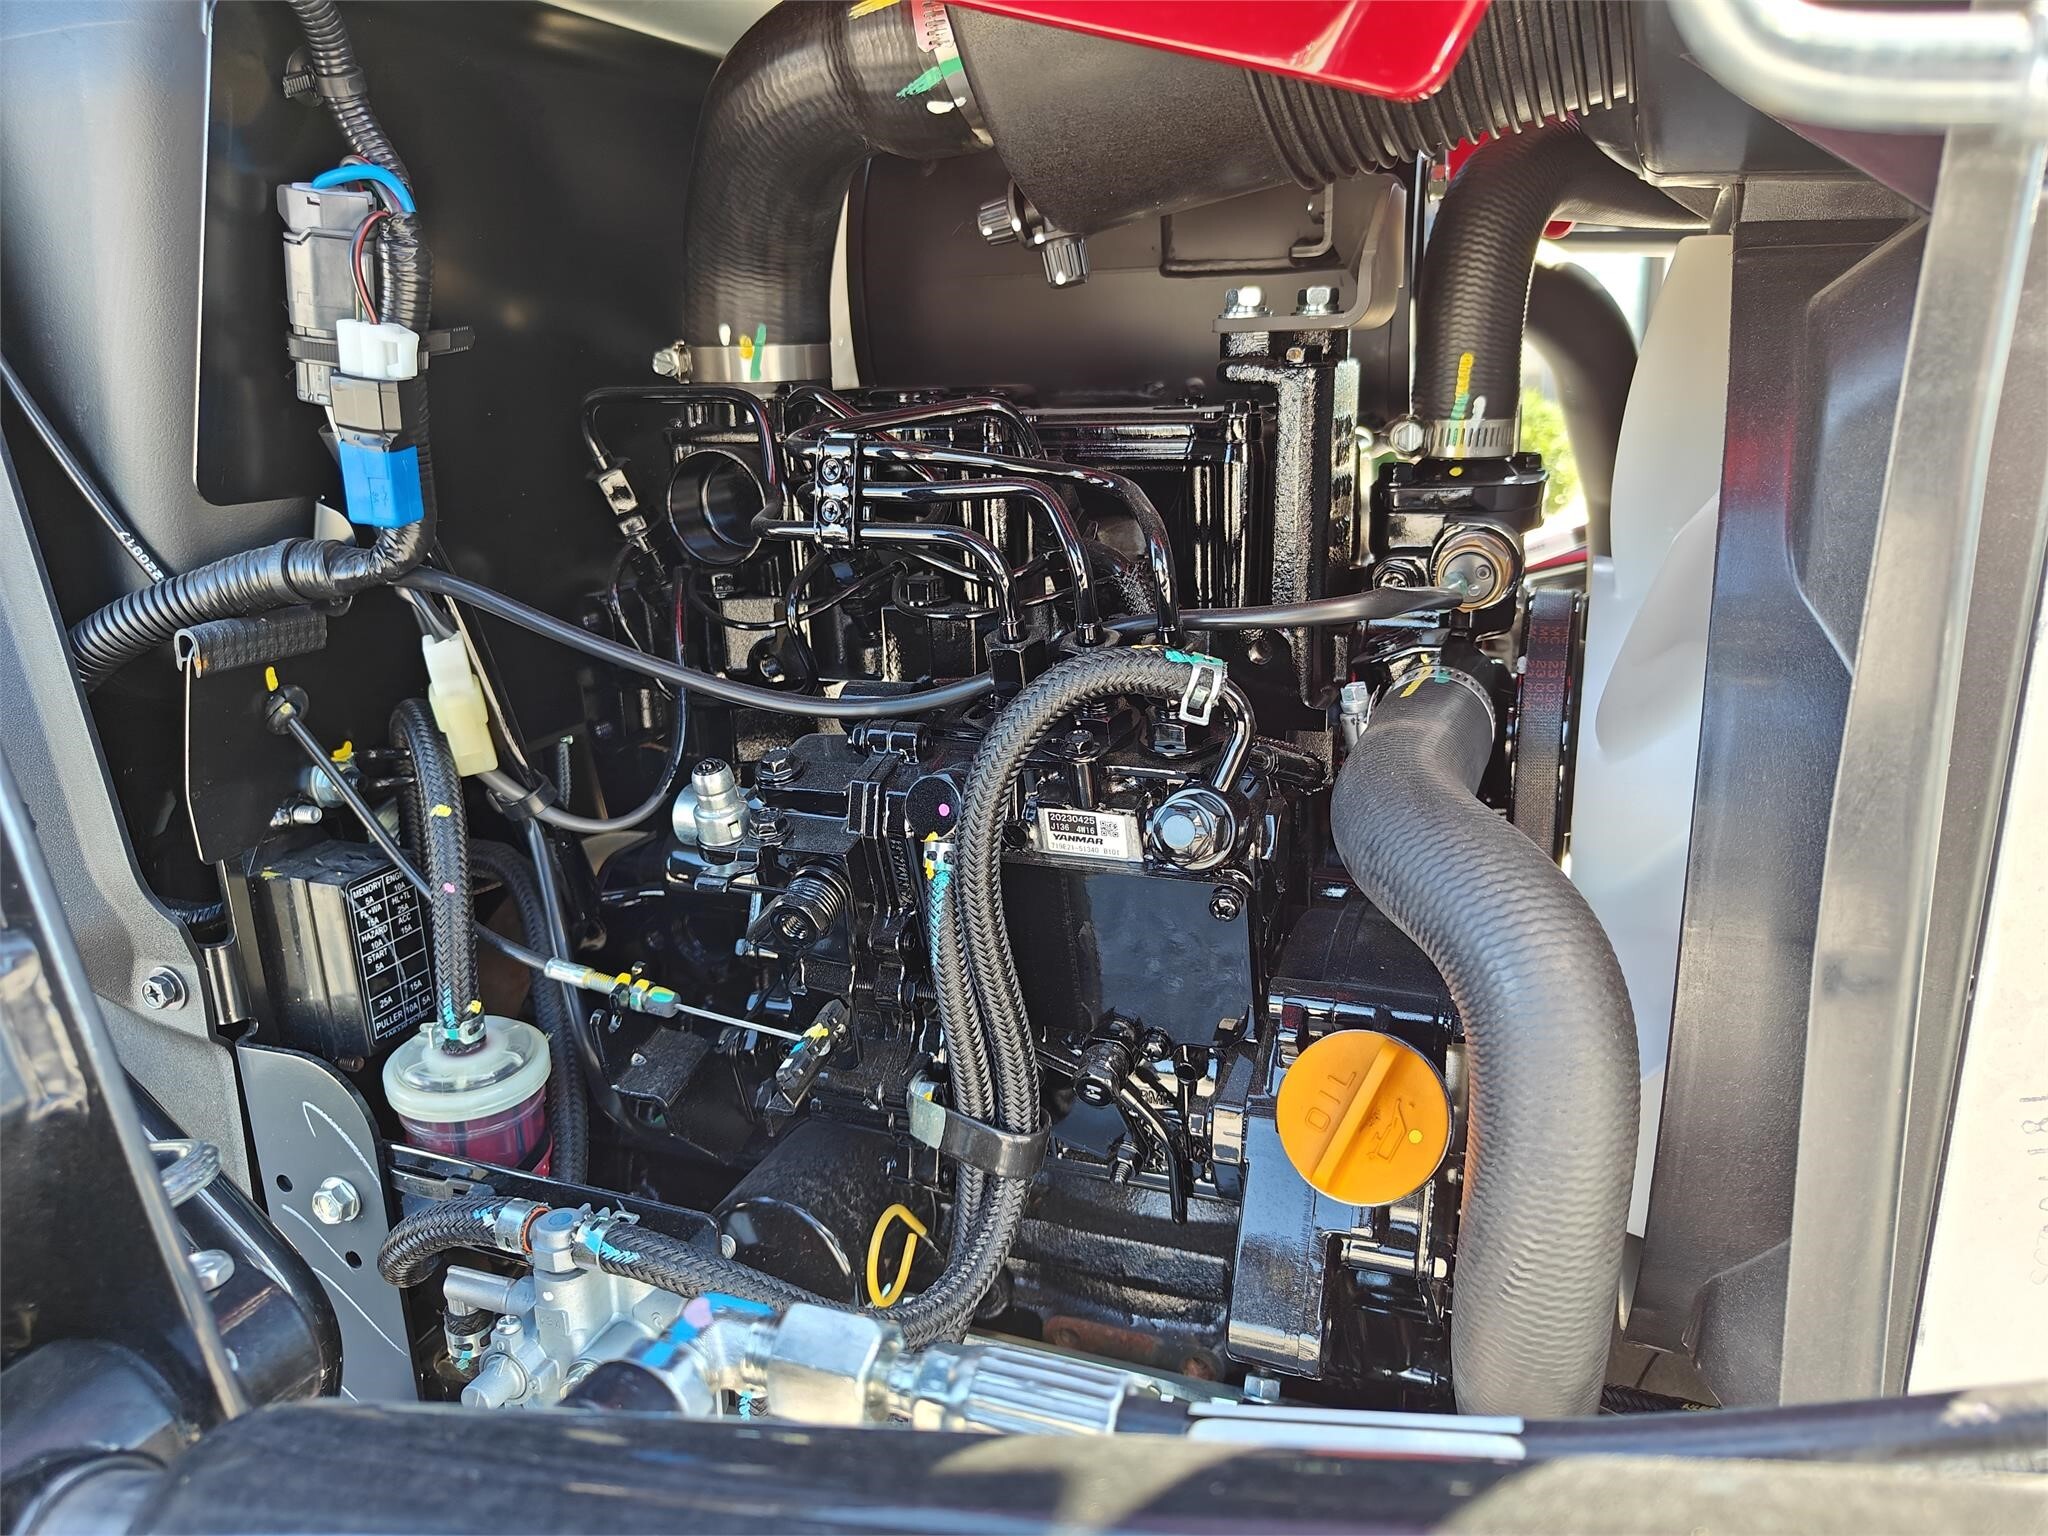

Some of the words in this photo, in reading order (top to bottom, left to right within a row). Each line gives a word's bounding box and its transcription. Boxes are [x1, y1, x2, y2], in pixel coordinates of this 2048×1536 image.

[1050, 814, 1096, 825] 20230425
[1053, 833, 1104, 845] YANMAR
[352, 879, 382, 899] MEMORY
[394, 881, 406, 892] 10A
[397, 903, 409, 914] 25A
[367, 916, 380, 928] 15A
[398, 912, 412, 925] ACC
[361, 924, 389, 944] HAZARD
[401, 923, 413, 934] 15A
[371, 938, 384, 950] 10A
[367, 947, 389, 965] START
[410, 979, 423, 992] 15A
[379, 995, 394, 1009] 25A
[405, 1001, 419, 1015] 10A
[375, 1010, 404, 1032] PULLER
[1305, 1071, 1357, 1133] OIL
